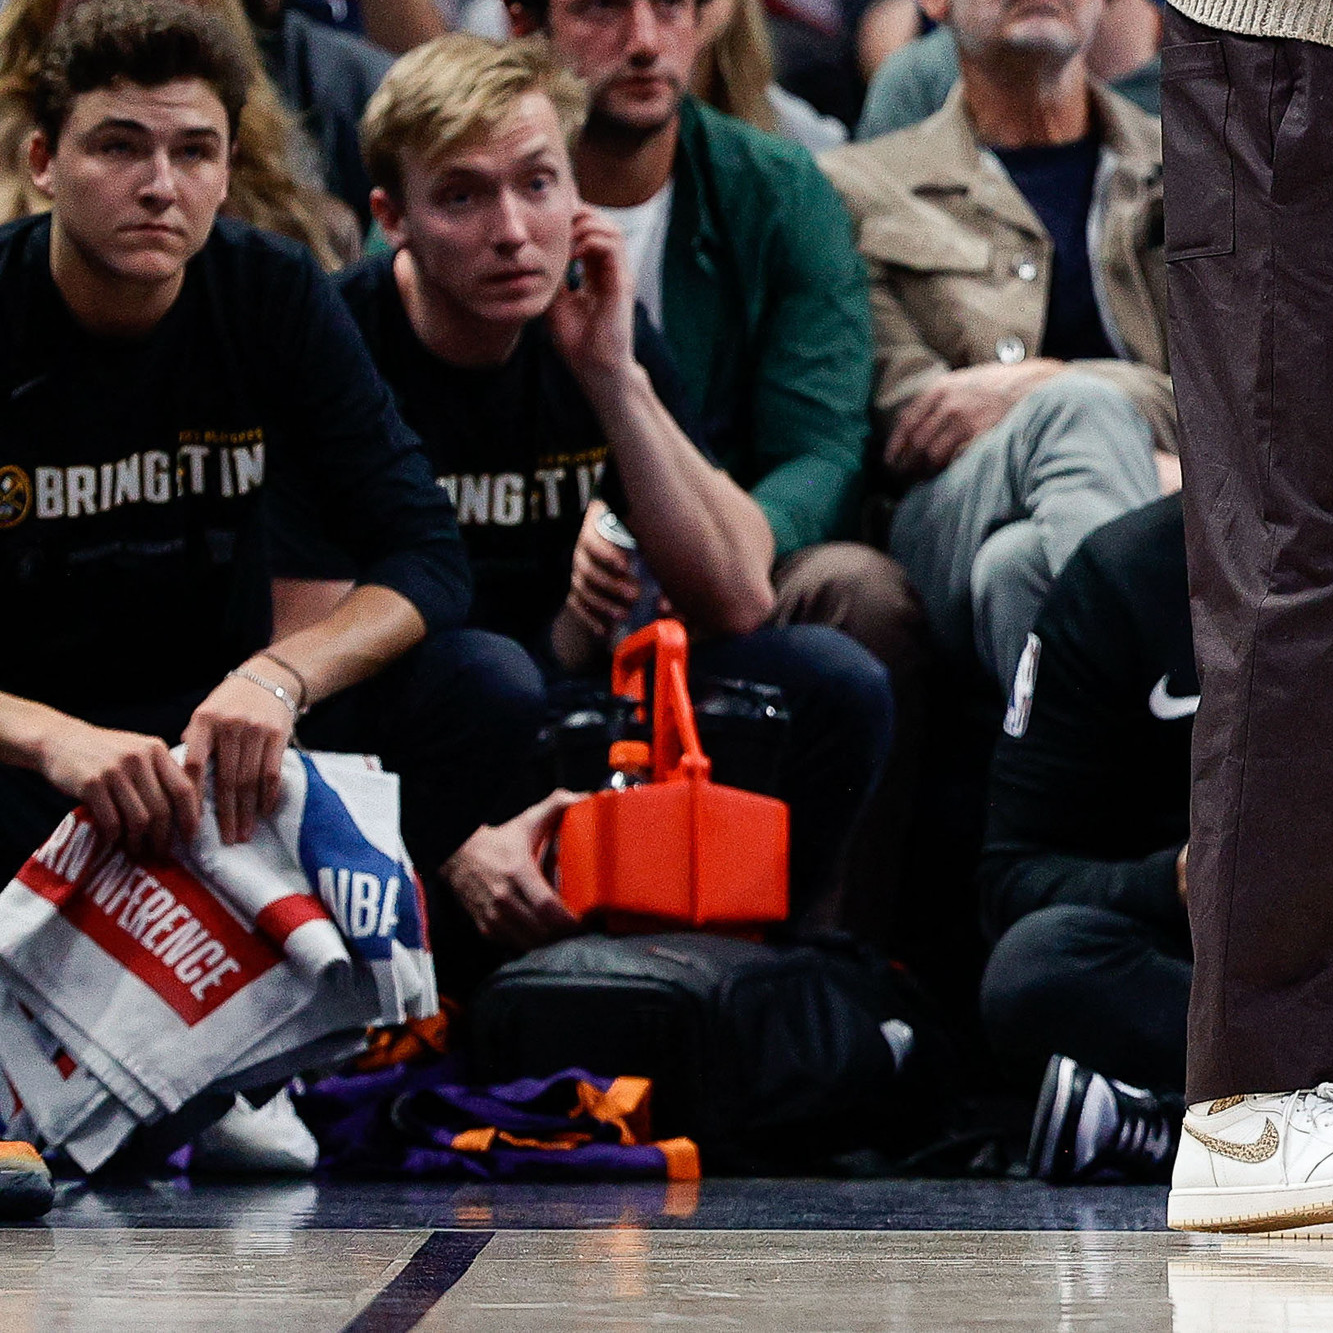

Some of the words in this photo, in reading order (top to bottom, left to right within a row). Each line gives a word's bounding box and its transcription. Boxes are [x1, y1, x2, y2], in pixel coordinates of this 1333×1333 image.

[35, 450, 172, 519] BRING
[219, 442, 266, 499] IN
[84, 850, 242, 1002] NFERENCE
